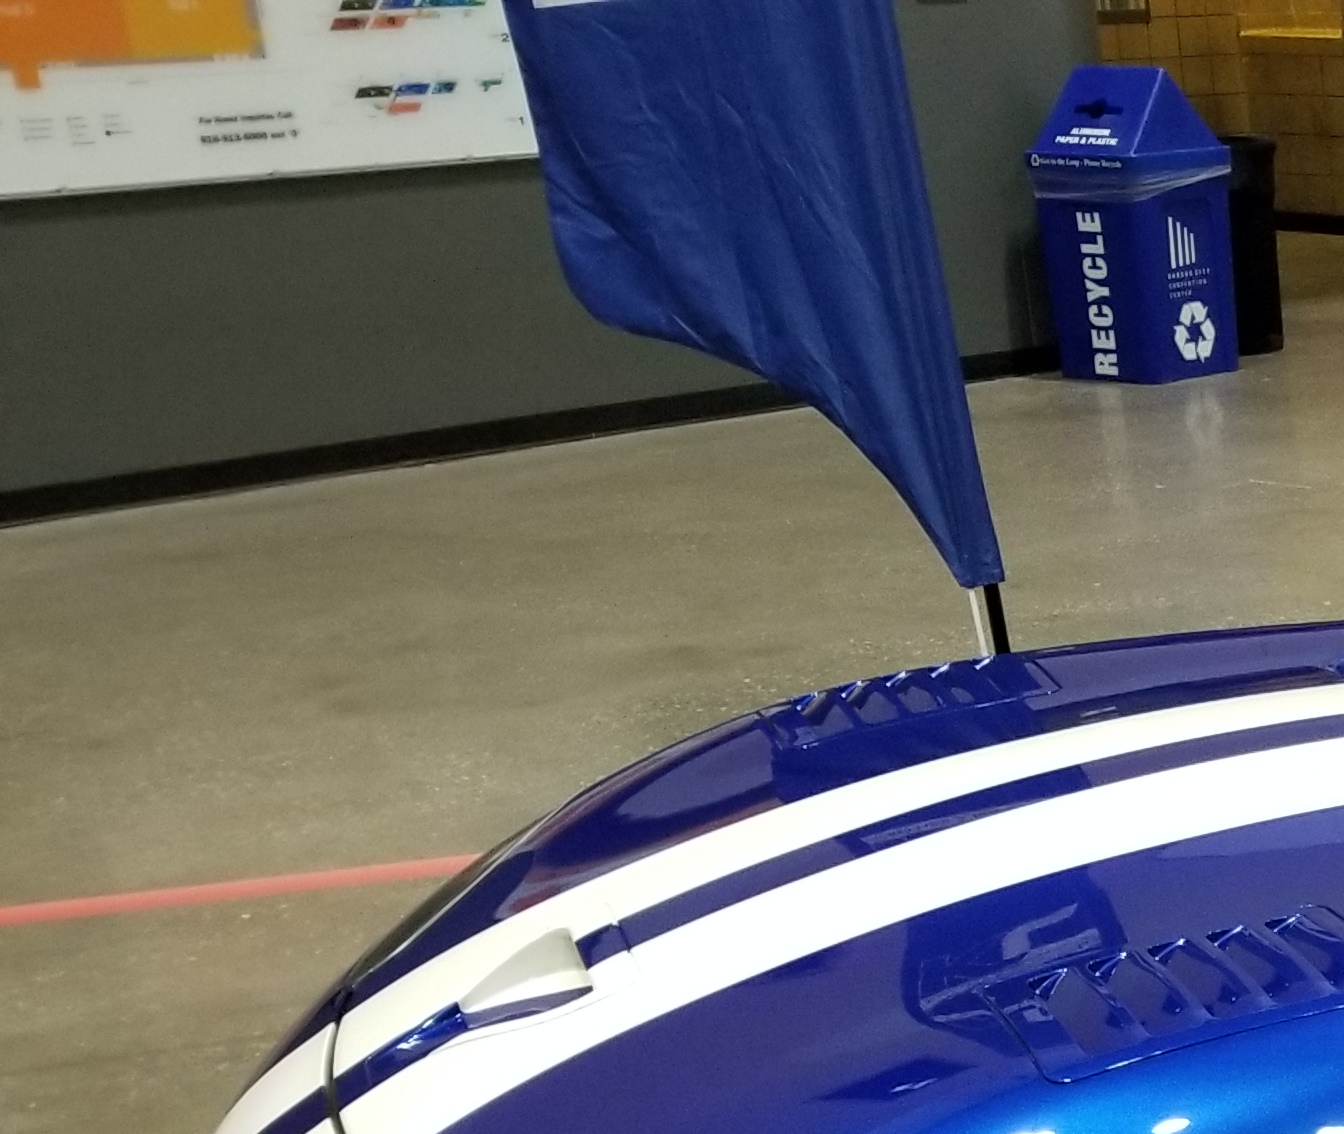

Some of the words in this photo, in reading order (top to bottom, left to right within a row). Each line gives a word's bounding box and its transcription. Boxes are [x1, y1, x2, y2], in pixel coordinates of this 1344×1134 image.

[1055, 135, 1080, 144] PAPER
[1086, 136, 1119, 146] PLASTIC
[1076, 212, 1119, 376] RECYCLE
